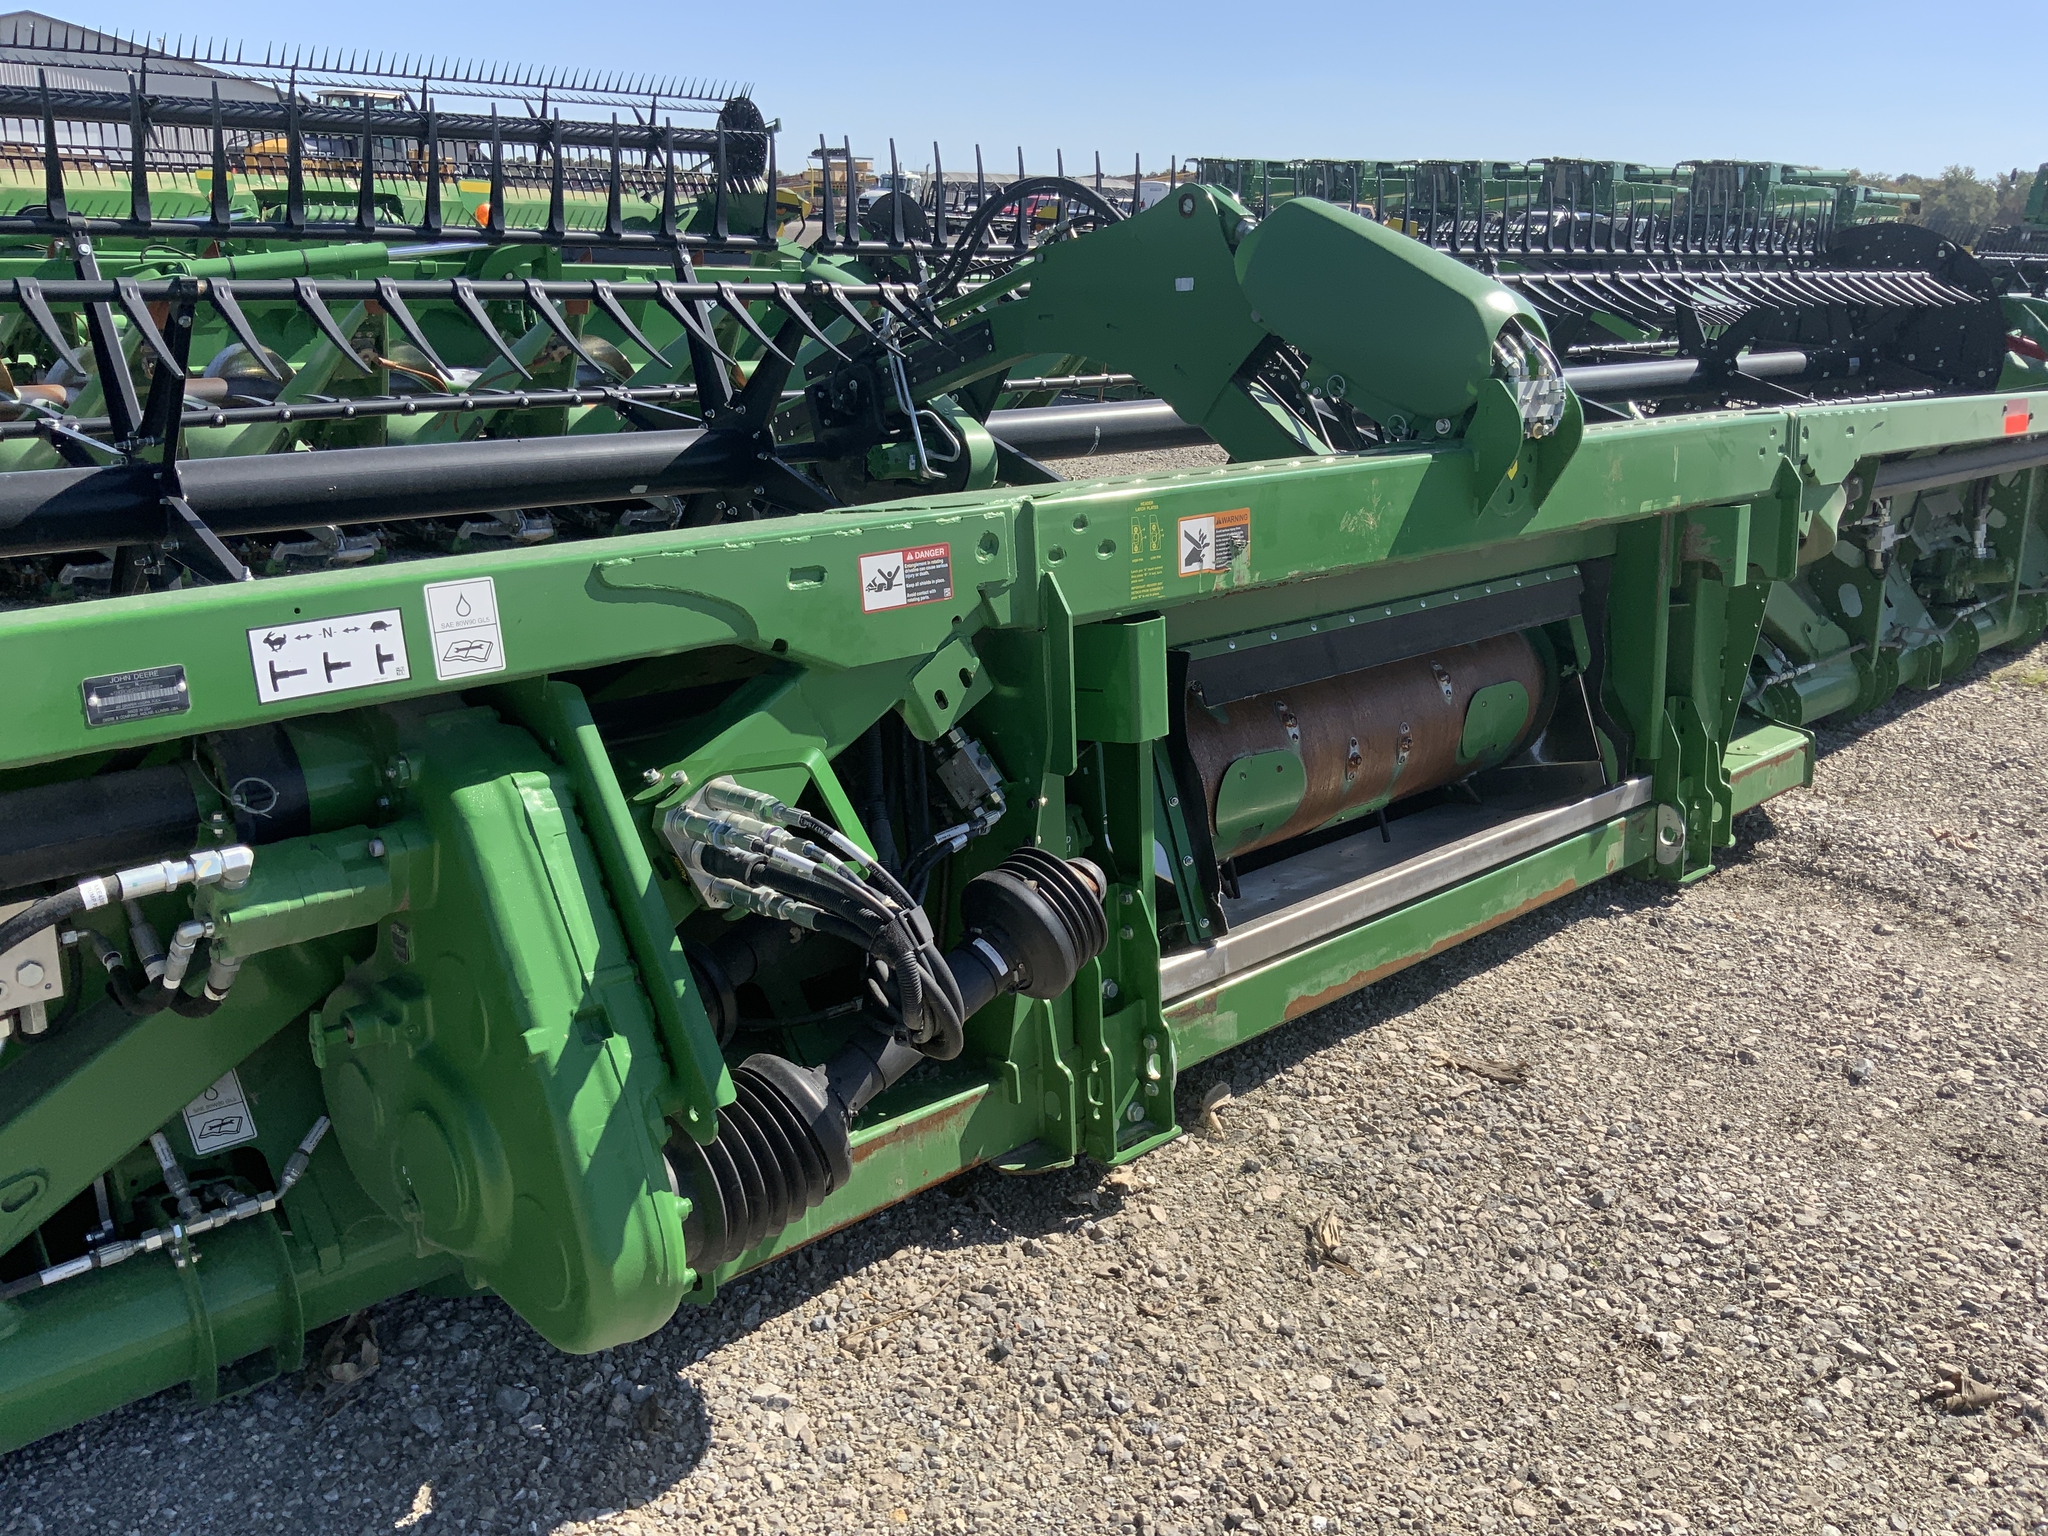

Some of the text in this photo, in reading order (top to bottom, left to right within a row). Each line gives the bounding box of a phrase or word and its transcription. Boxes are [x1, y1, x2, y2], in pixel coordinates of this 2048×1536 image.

[1222, 514, 1248, 524] WARNING
[914, 548, 945, 560] DANGER
[441, 621, 454, 630] SAE
[456, 619, 476, 627] 80W90
[109, 670, 159, 684] JOHN DEERE
